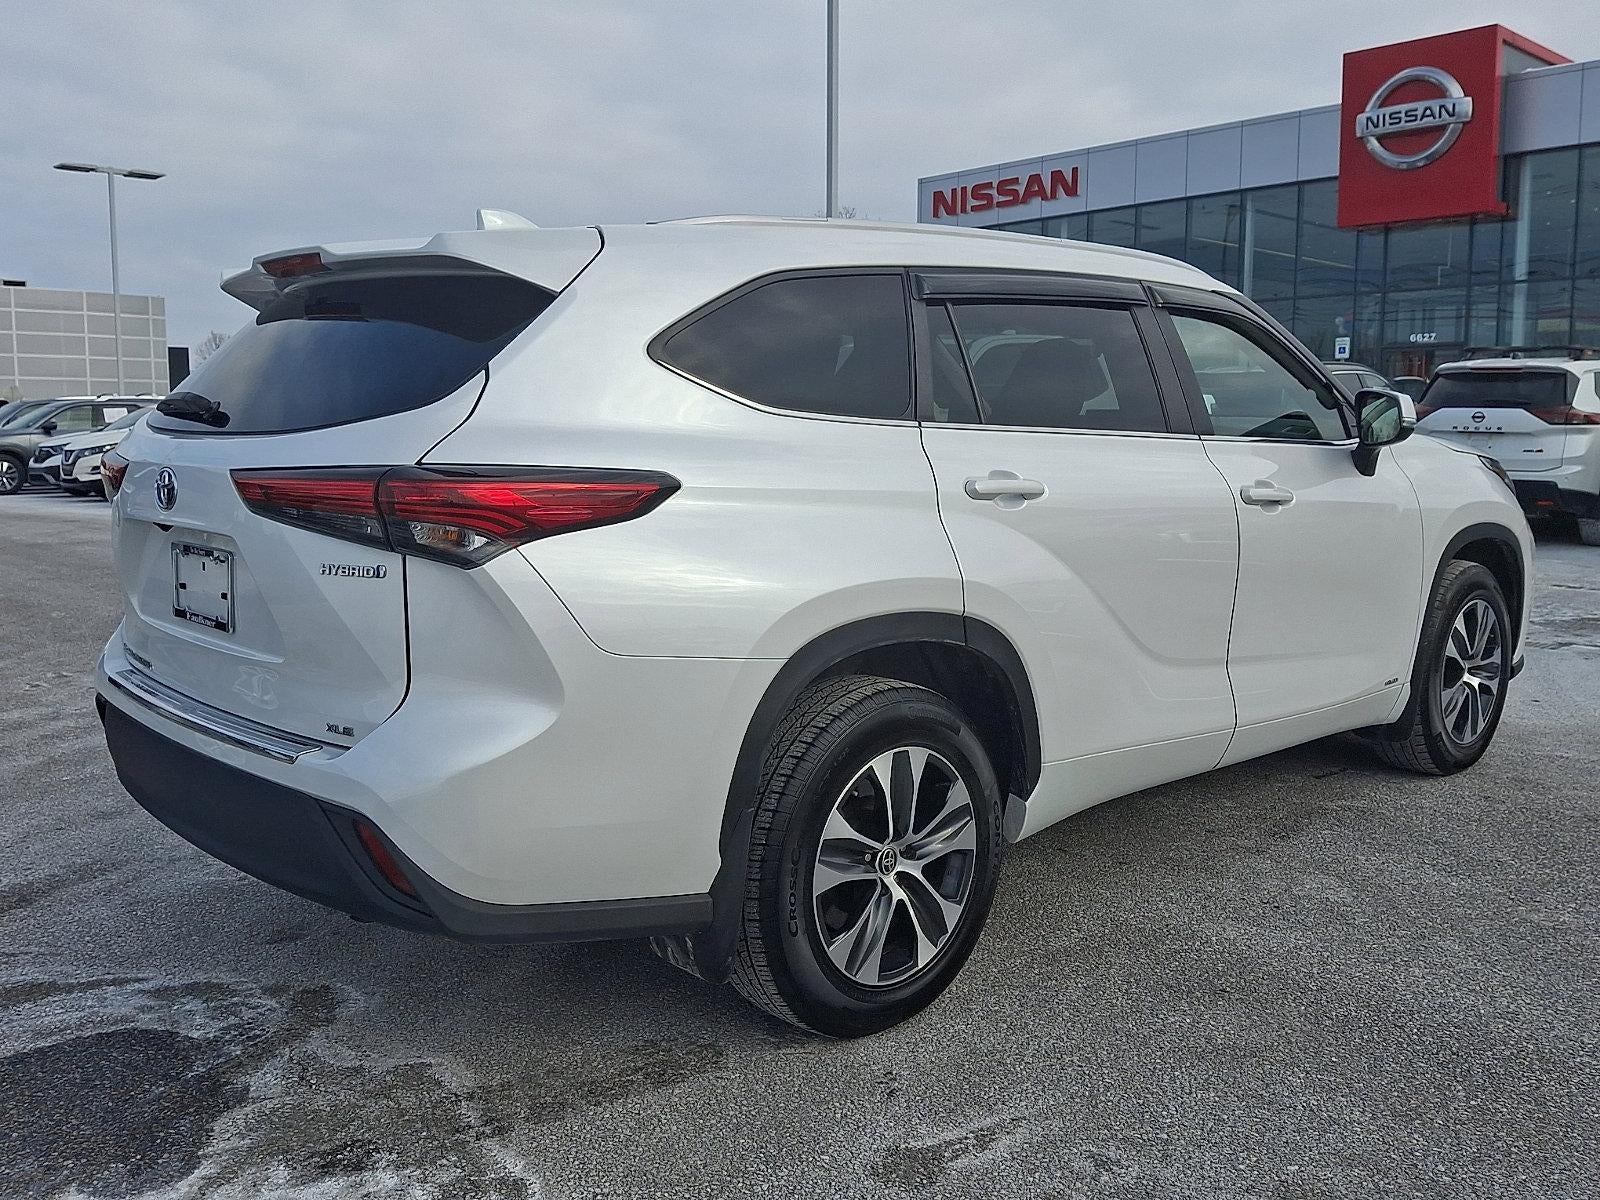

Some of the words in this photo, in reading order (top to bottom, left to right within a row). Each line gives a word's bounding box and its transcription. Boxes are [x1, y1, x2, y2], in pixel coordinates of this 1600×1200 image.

[1365, 103, 1456, 130] NISSAN
[933, 167, 1079, 218] NISSAN
[1409, 333, 1437, 343] 6627
[320, 563, 376, 578] HYBRID
